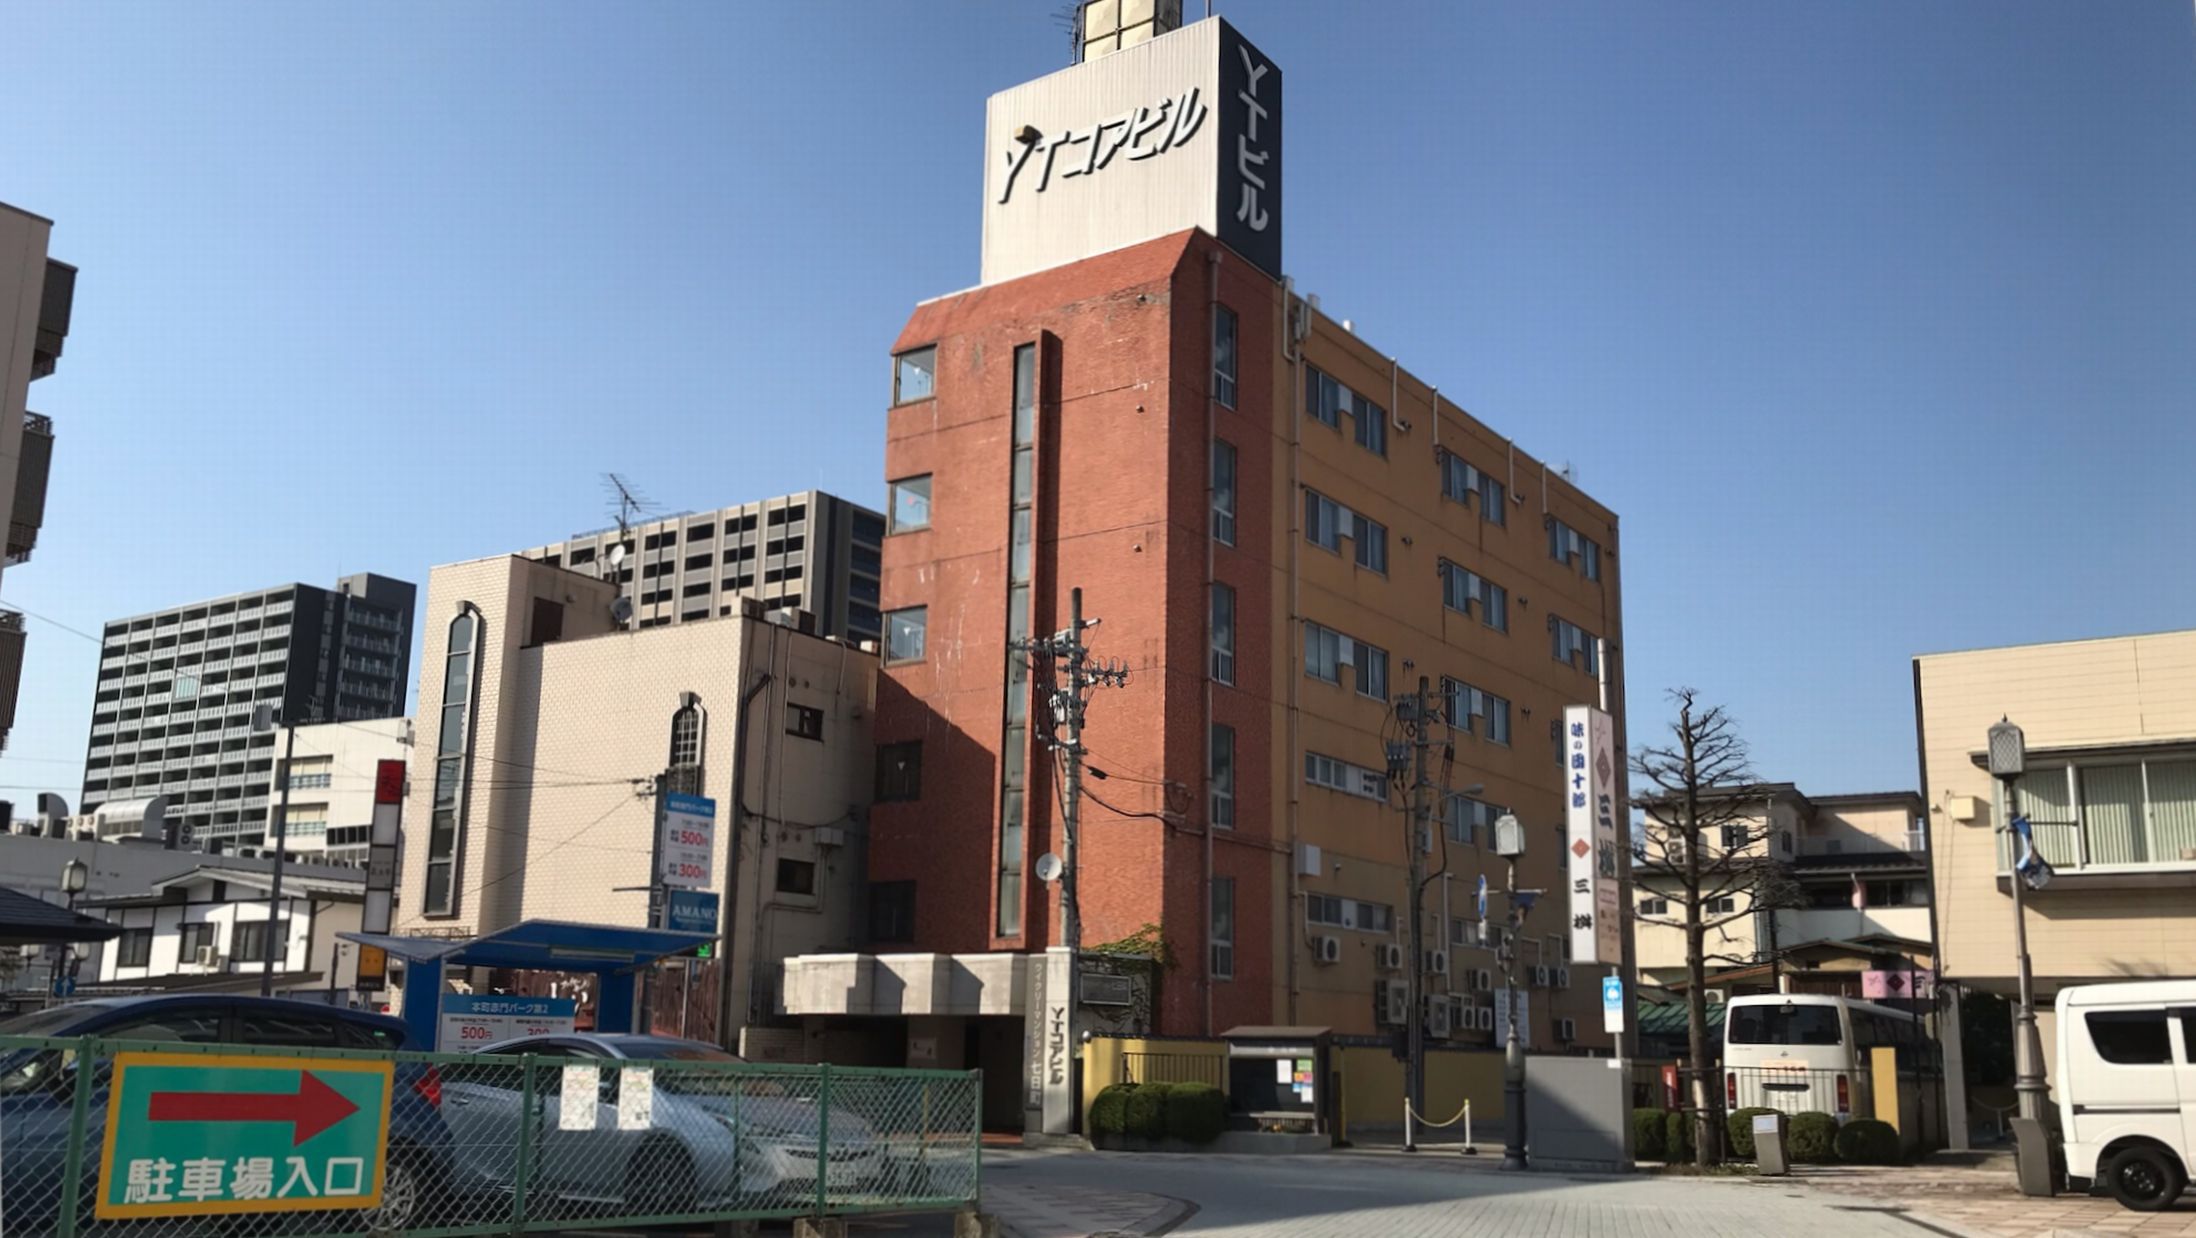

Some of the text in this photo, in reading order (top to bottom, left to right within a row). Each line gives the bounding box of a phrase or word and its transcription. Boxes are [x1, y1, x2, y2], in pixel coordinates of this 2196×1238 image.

[998, 86, 1208, 205] YTコアビル
[1236, 44, 1270, 232] YTビル
[672, 904, 717, 920] AMANO
[460, 1026, 493, 1040] 500円
[1049, 1006, 1065, 1085] YTコアビル
[123, 1156, 365, 1206] 駐車場入口
